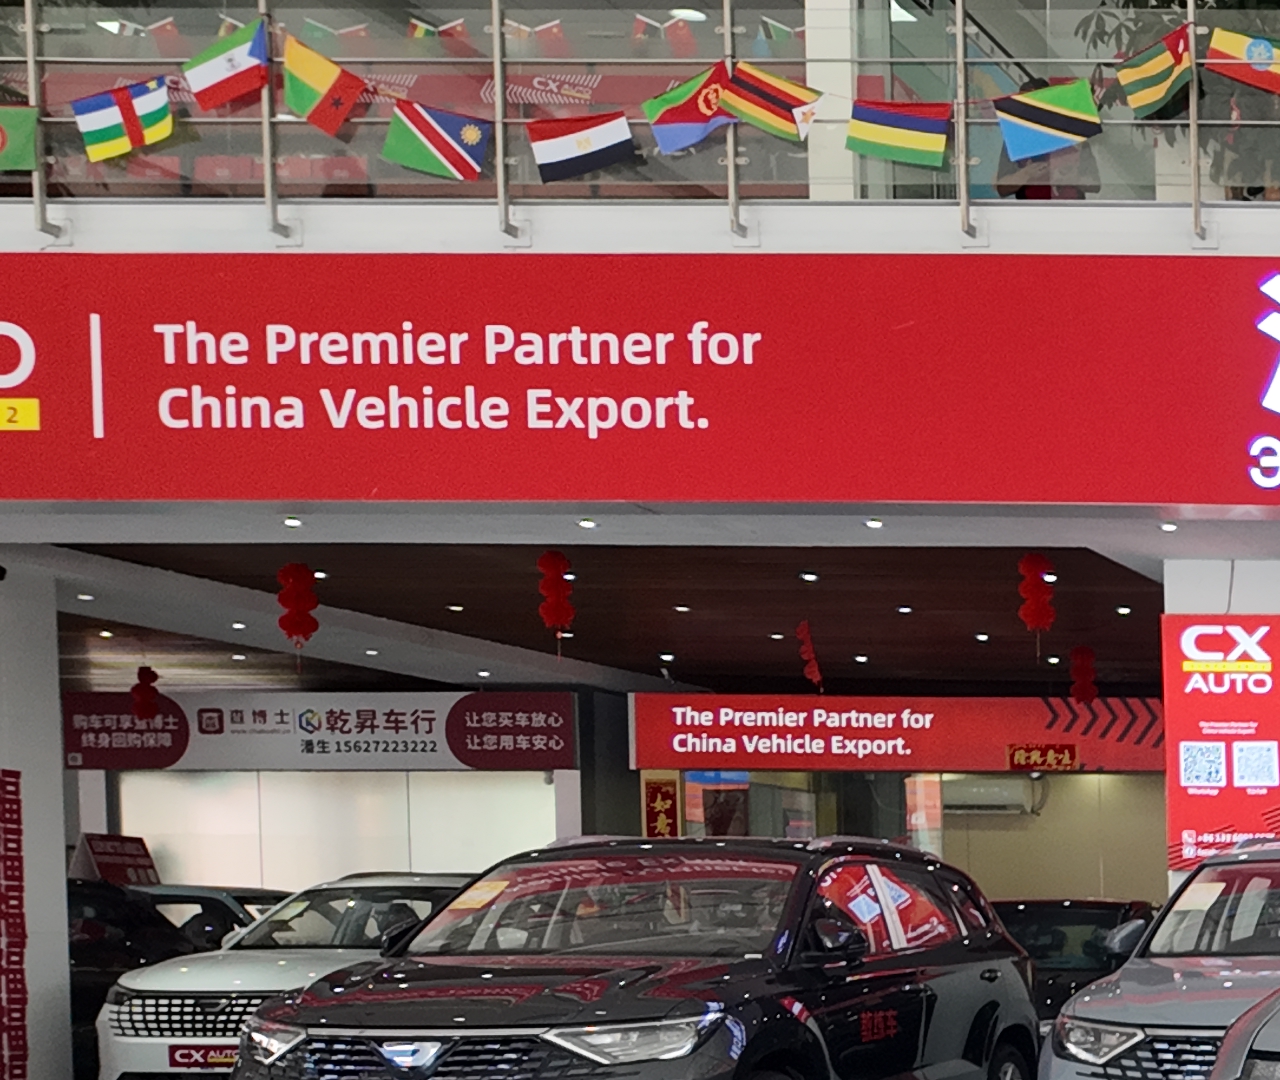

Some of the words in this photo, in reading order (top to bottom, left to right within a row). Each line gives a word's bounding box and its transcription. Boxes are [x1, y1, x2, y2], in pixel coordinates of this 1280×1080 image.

[532, 77, 559, 92] CX
[153, 322, 249, 365] The
[267, 322, 469, 365] Premier
[485, 323, 674, 365] Partner
[687, 322, 762, 365] for
[158, 387, 304, 429] China
[321, 388, 509, 430] Vehicle
[527, 388, 709, 438] Export.
[1181, 625, 1271, 661] CX
[1184, 673, 1272, 694] AUTO
[325, 708, 437, 735] 乾昇车行
[465, 712, 563, 728] 让您买车放心
[672, 706, 714, 727] The
[719, 707, 807, 730] Premier
[813, 708, 895, 730] Partner
[901, 709, 934, 729] for
[335, 740, 438, 753] 15627223222
[466, 735, 564, 751] 让您用车安心
[673, 734, 737, 755] China
[743, 735, 825, 755] Vehicle
[831, 737, 911, 759] Export.
[174, 1050, 205, 1063] CX
